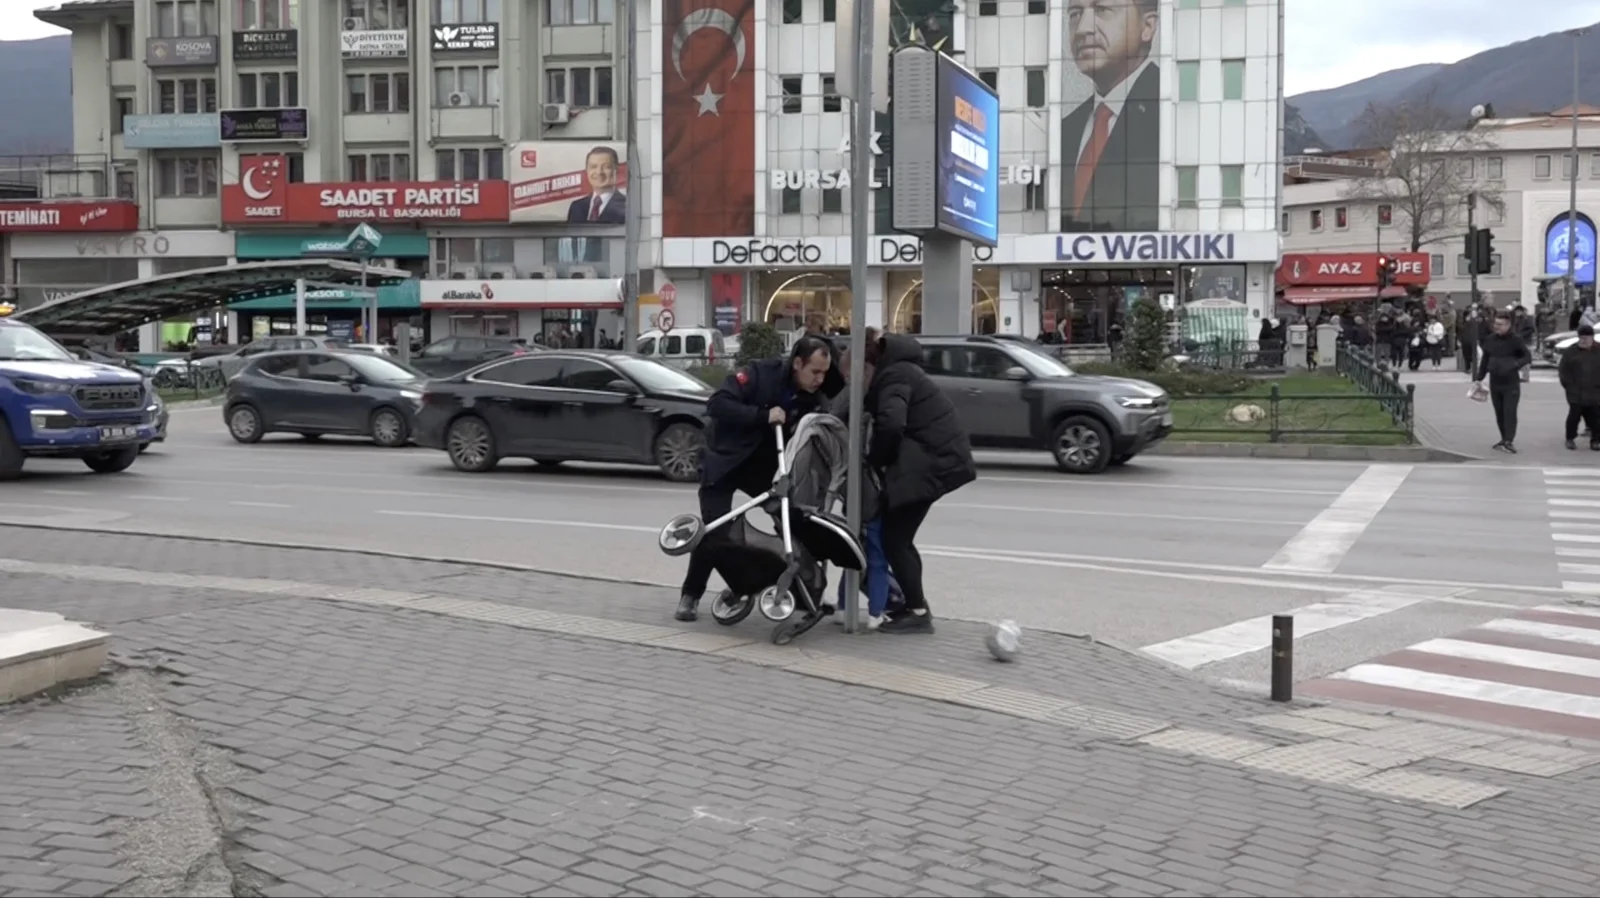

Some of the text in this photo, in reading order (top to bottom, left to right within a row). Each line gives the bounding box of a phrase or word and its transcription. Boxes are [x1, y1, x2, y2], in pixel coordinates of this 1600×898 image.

[175, 41, 212, 51] KOSOVA
[359, 33, 405, 41] DİYETİSYEN
[770, 168, 850, 190] BURSA
[320, 183, 480, 206] SAADET PARTİSİ
[0, 208, 60, 226] TEMİNATI
[245, 206, 282, 216] SAADET
[337, 207, 461, 218] BURSA İL BAŞKANLIĞI
[75, 236, 170, 255] VAYRO
[713, 240, 821, 264] DeFacto
[1056, 235, 1096, 260] LC
[1318, 262, 1362, 274] AYAZ
